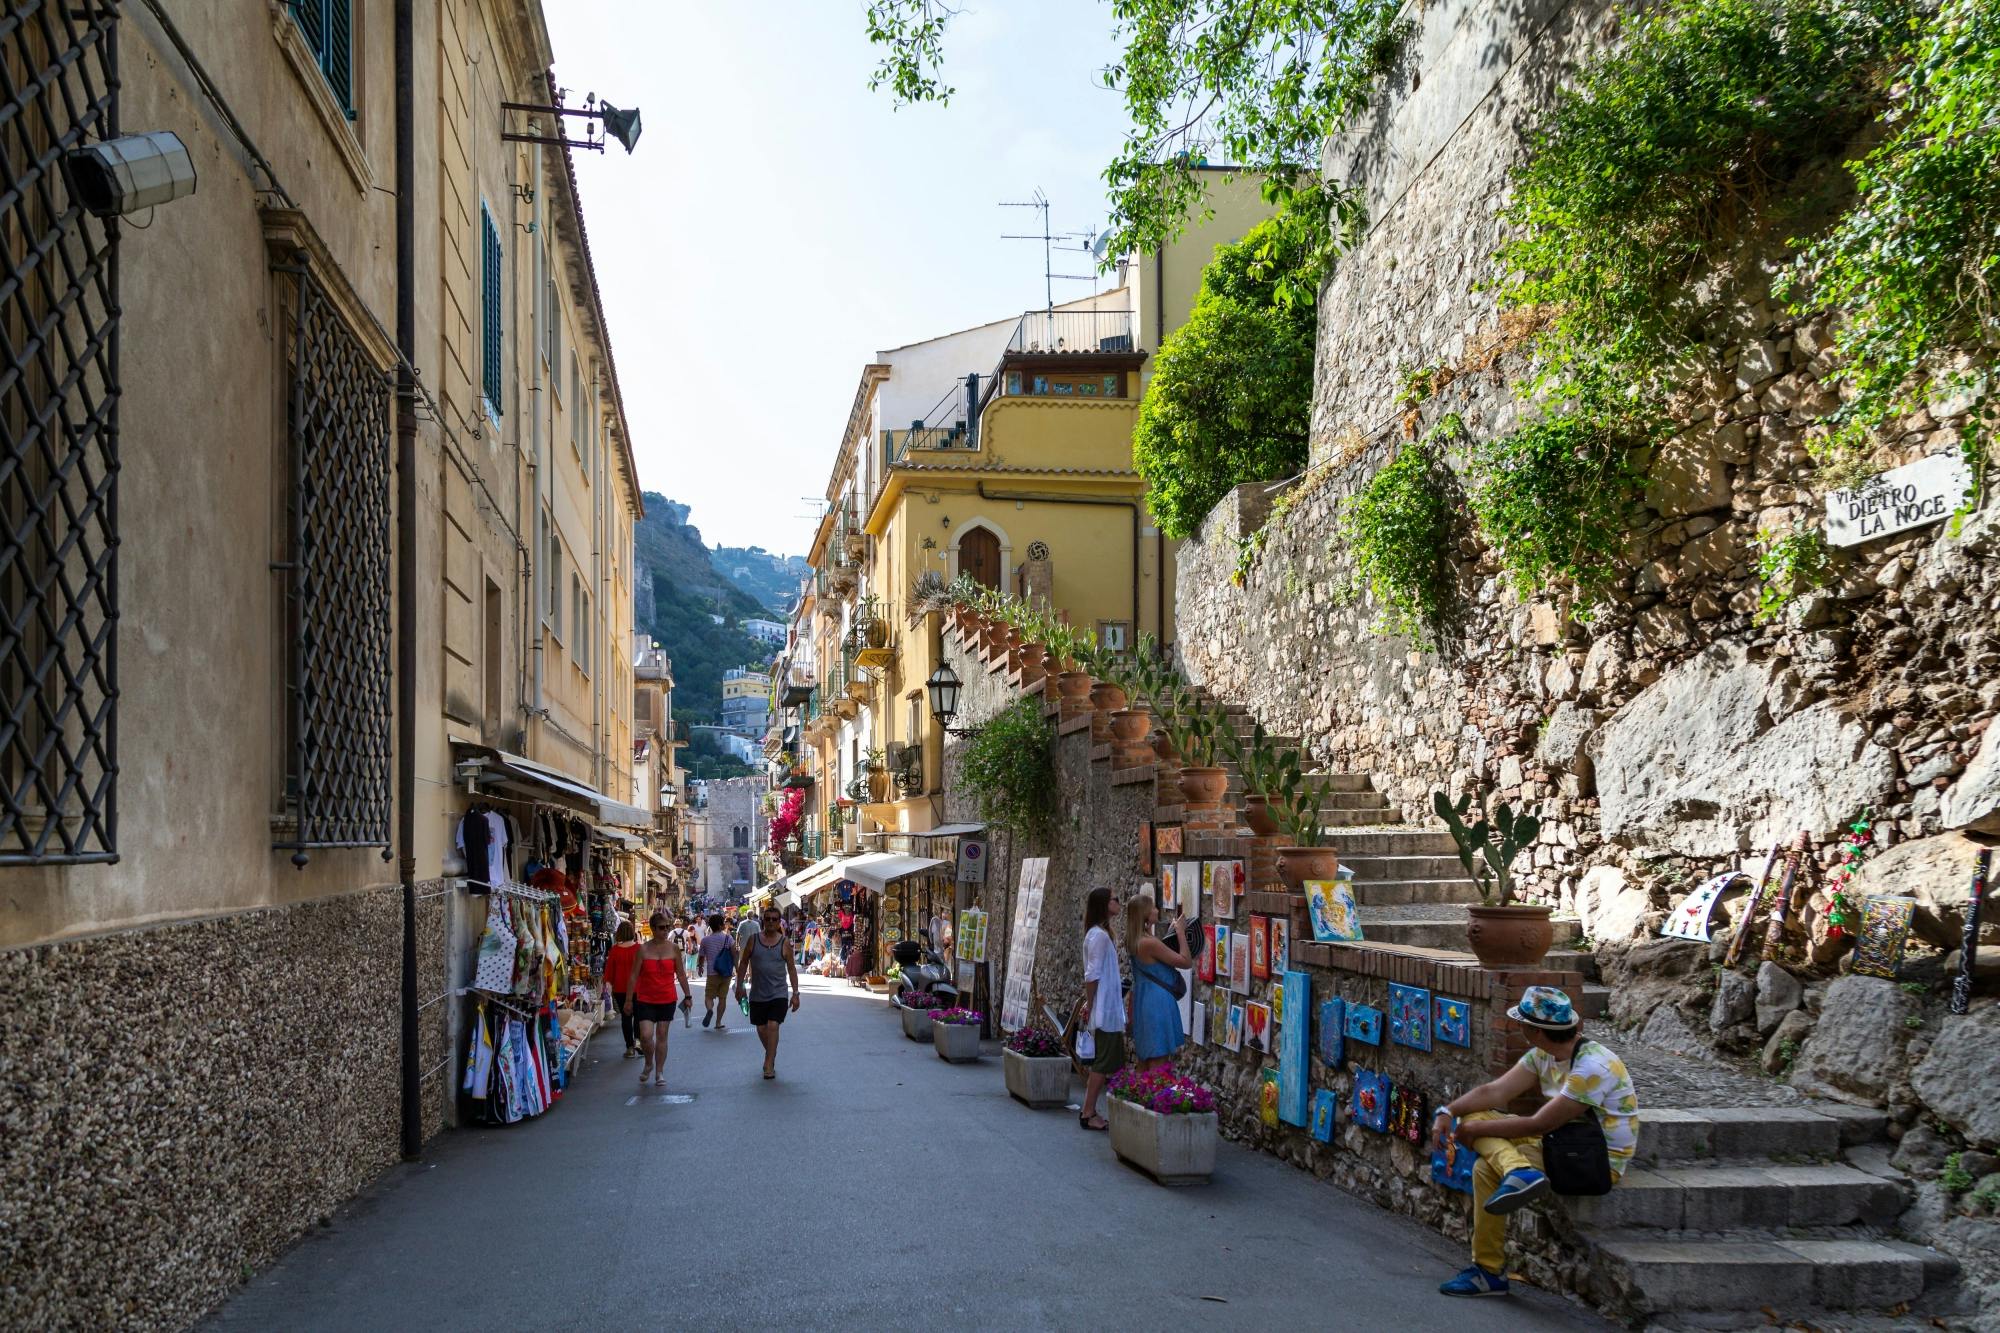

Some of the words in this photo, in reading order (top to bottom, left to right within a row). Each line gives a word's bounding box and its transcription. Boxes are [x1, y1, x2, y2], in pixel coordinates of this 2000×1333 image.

[1849, 484, 1917, 521] DIETRO
[1860, 514, 1885, 536] LA
[1896, 494, 1946, 527] NOCE
